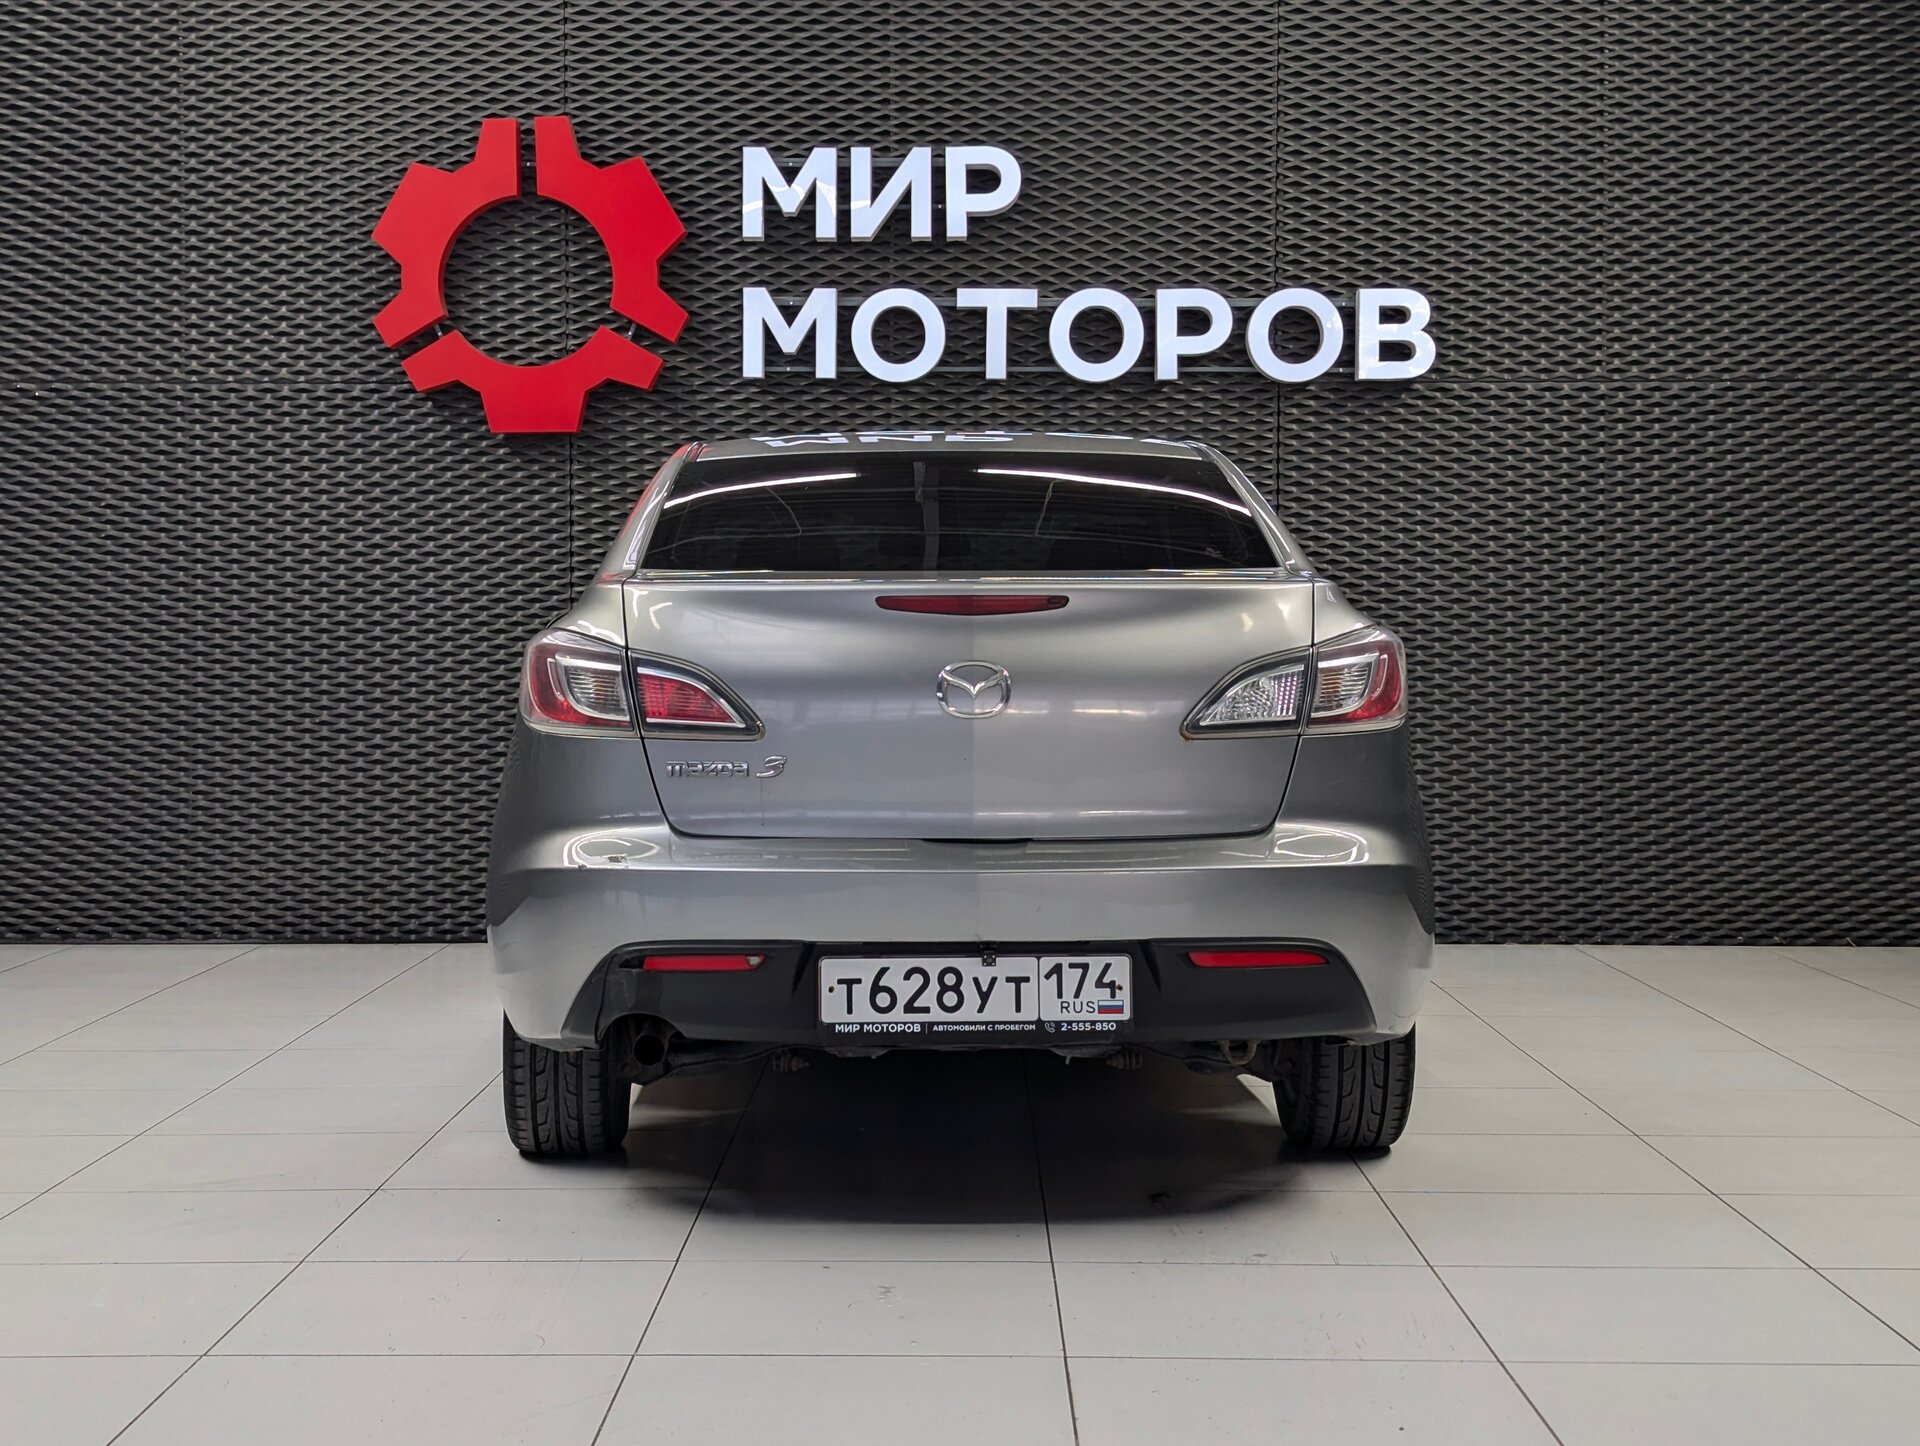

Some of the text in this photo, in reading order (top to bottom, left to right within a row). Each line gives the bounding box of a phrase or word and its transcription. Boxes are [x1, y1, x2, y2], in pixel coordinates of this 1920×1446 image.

[742, 146, 1022, 239] МИР
[742, 286, 1437, 383] МОТОРОВ
[755, 754, 787, 778] 3
[1043, 962, 1117, 999] 174
[1060, 1000, 1096, 1014] RUS
[835, 1022, 1117, 1033] МИР МОТОРОВ АВТОМОБИЛИ С ПРОБЕГОМ 2-555-850
